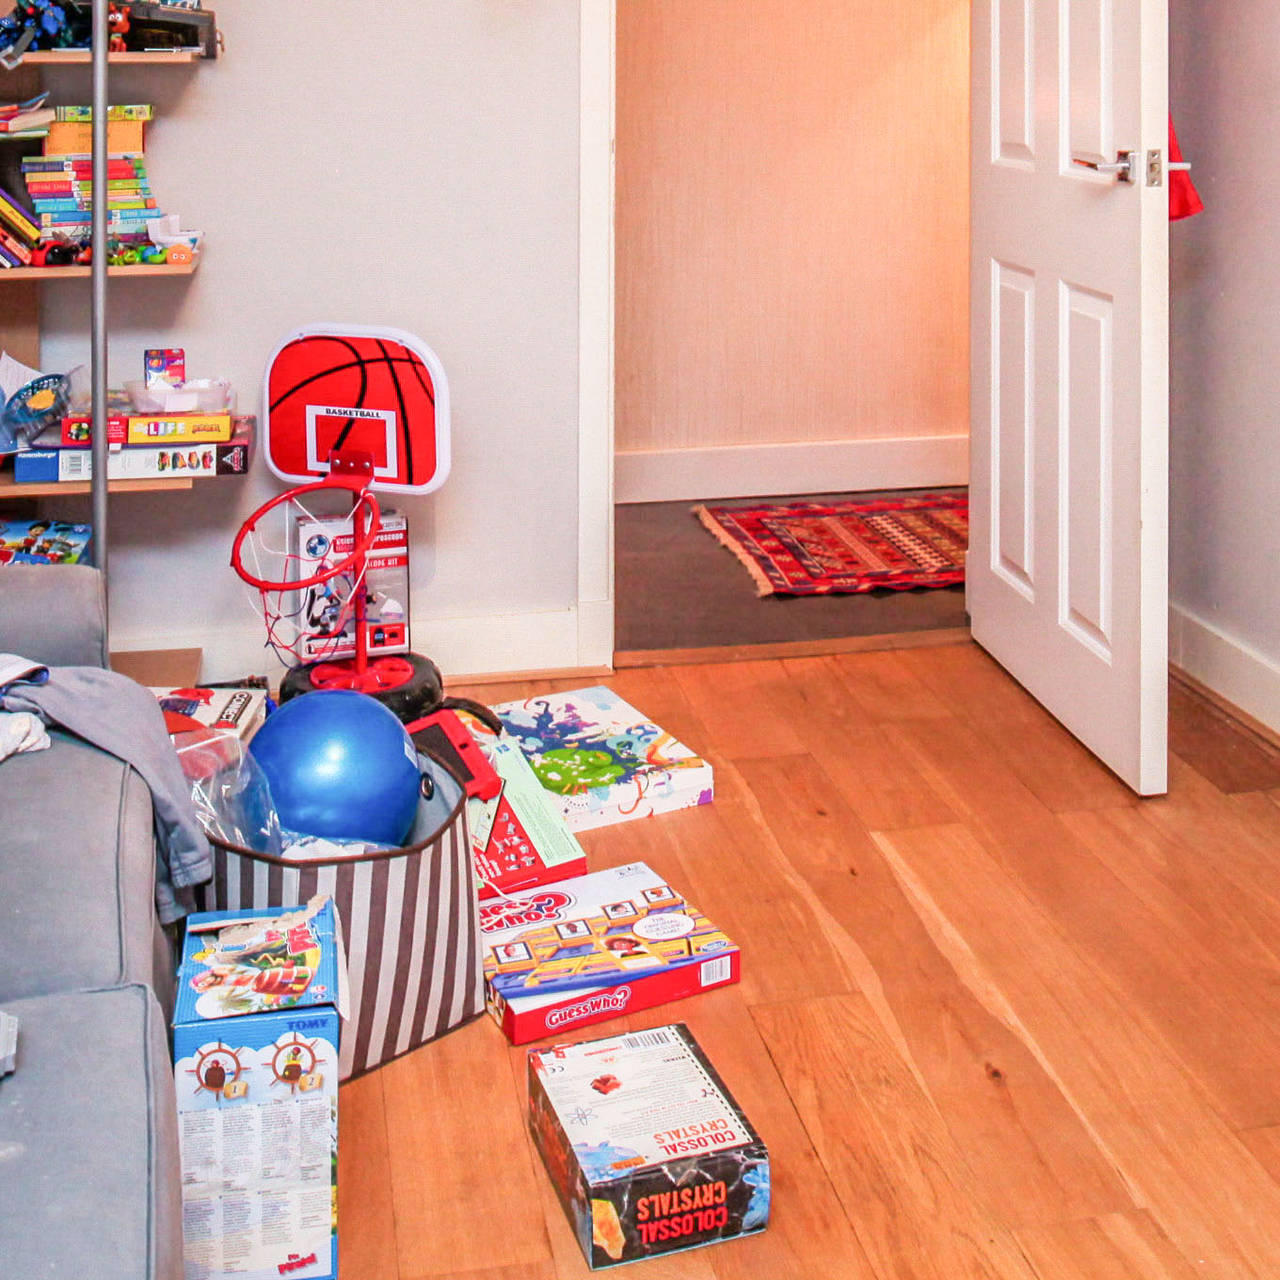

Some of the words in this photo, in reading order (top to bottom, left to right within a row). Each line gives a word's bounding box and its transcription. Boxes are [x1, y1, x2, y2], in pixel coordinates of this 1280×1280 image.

[325, 407, 381, 419] BASKETBALL
[147, 421, 186, 437] LIFE
[547, 1003, 590, 1026] Guess
[588, 987, 630, 1013] Who?
[287, 1018, 328, 1031] TOMY
[653, 1118, 729, 1144] CRYSTALS
[659, 1130, 736, 1156] COLOSSAL
[637, 1180, 727, 1221] CRYSTALS
[637, 1206, 728, 1244] COLOSSAL
